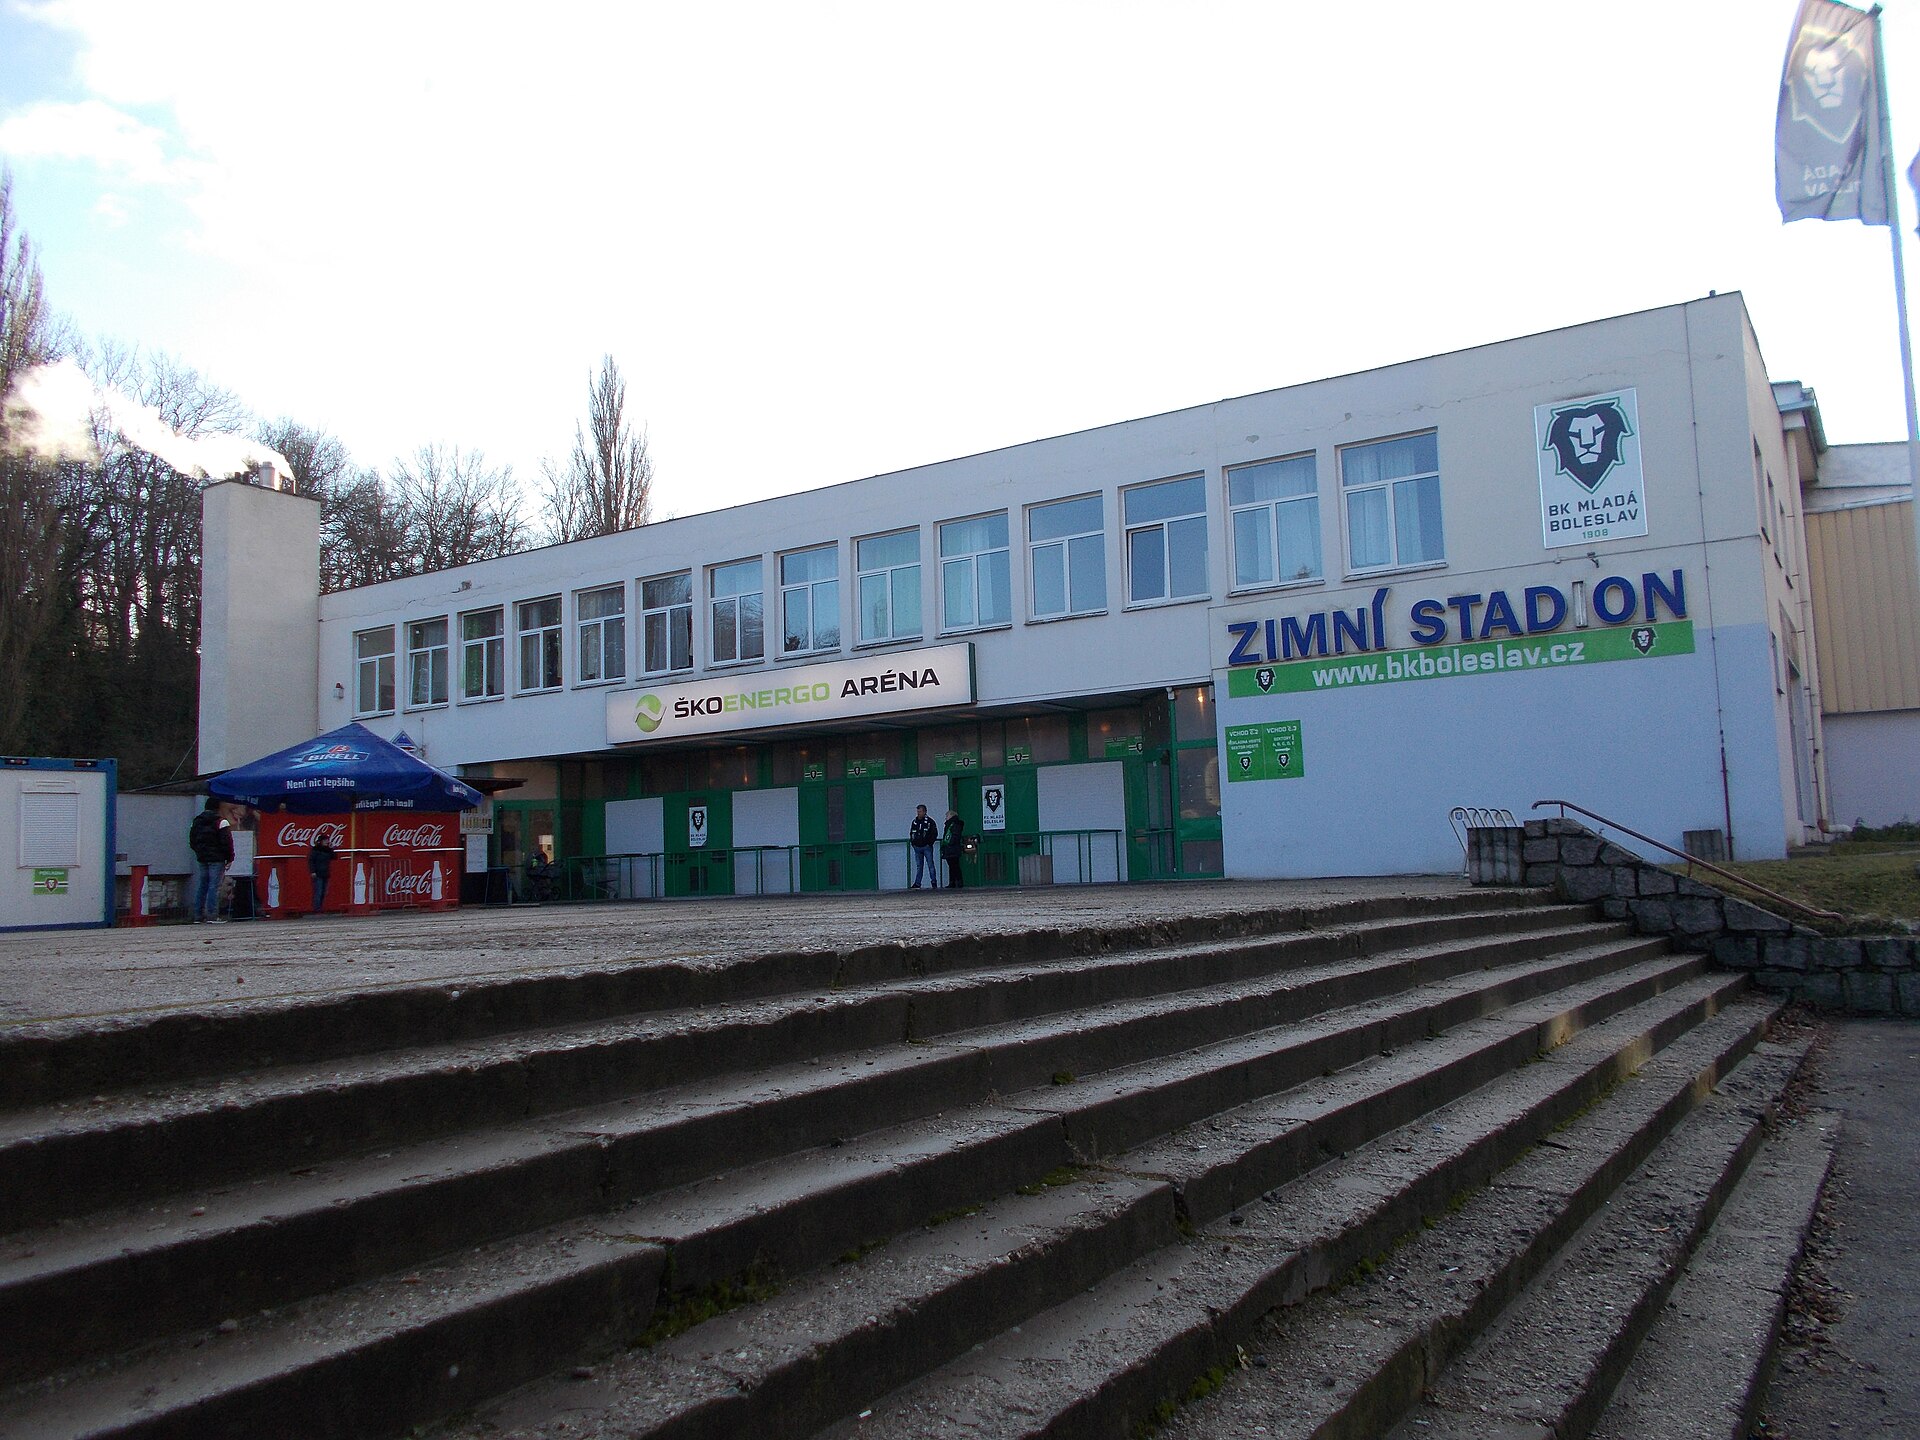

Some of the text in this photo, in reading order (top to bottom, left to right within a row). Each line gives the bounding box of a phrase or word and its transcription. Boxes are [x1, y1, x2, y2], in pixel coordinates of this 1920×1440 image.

[1549, 490, 1638, 517] BK MLADÁ
[1550, 508, 1639, 532] BOLESLAV
[1582, 528, 1609, 539] 1908
[1227, 568, 1688, 665] ZIMNÍ STADION
[1312, 641, 1585, 687] www.bkboleslav.cz
[674, 668, 941, 719] ŠKOENERGO ARÉNA
[308, 753, 360, 761] BIRELL
[286, 777, 355, 789] Není nic lepšího
[382, 823, 445, 847] Coca-Cola
